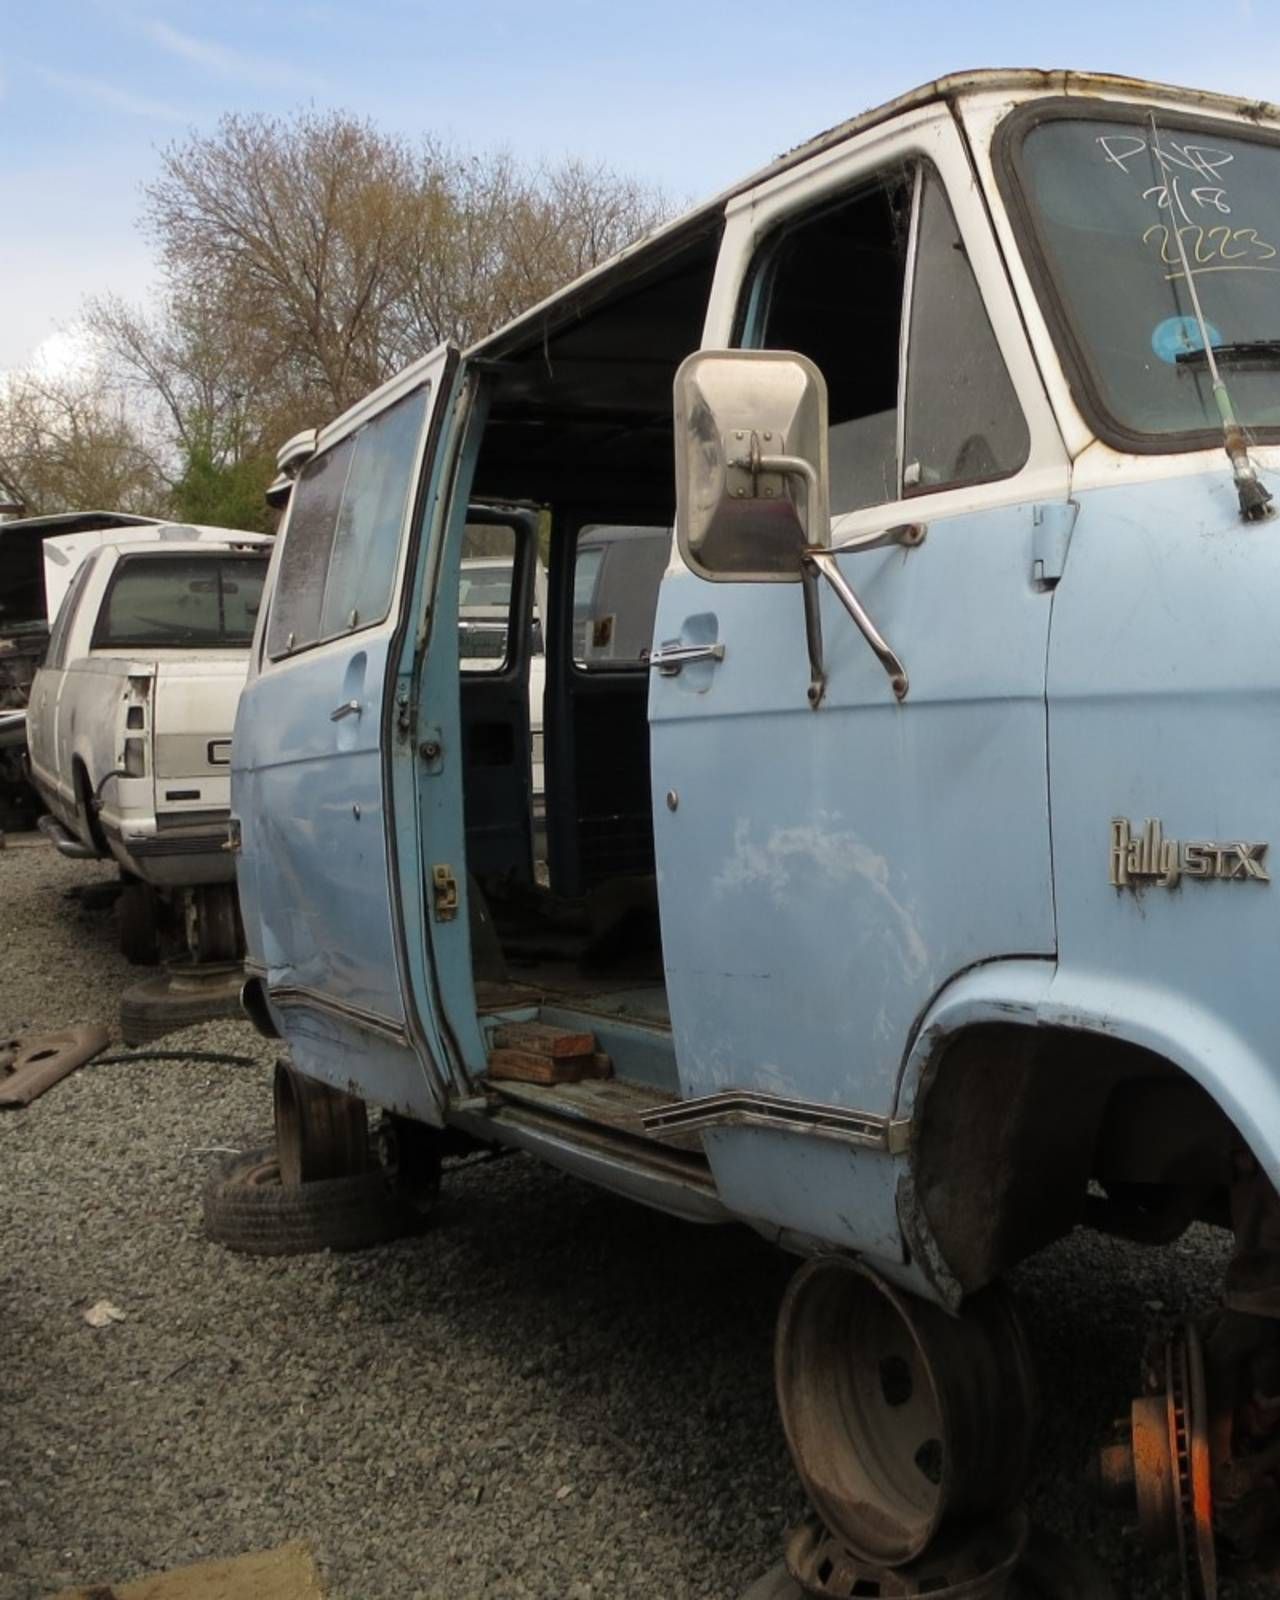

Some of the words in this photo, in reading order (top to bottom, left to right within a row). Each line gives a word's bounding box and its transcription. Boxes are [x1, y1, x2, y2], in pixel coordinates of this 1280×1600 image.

[1142, 223, 1277, 264] 2223
[1108, 816, 1182, 888] Rally
[1183, 840, 1271, 882] STX
